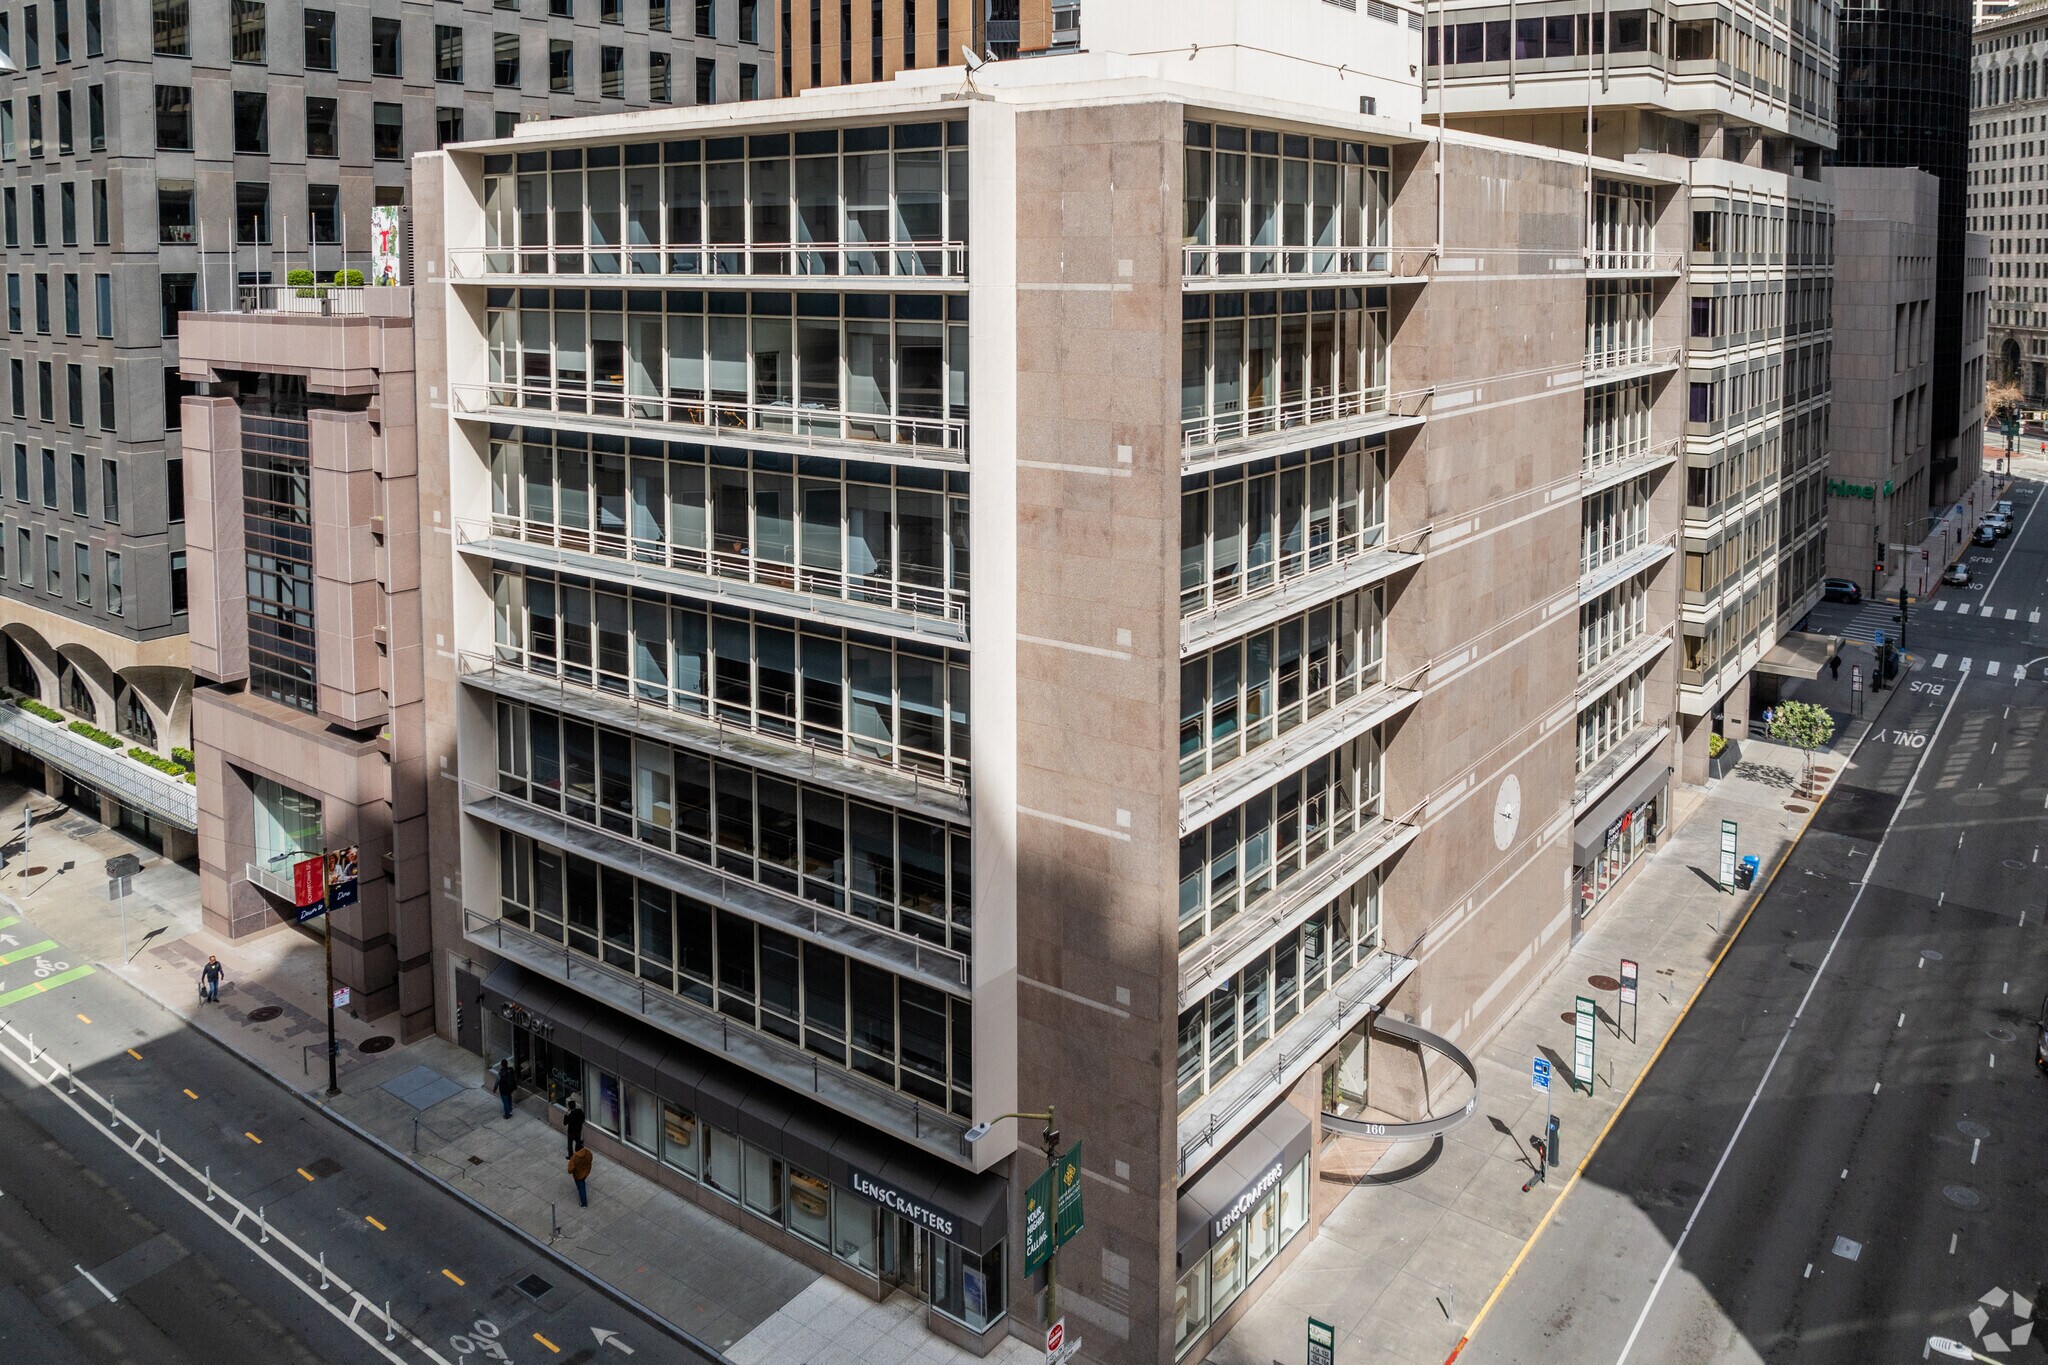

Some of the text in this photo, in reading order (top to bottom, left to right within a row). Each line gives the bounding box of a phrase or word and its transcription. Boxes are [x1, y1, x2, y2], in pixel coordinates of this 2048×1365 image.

[1827, 478, 1875, 499] hime
[1970, 556, 1993, 564] BUS
[1909, 681, 1944, 695] BUS
[1872, 728, 1926, 748] ONLY
[1365, 1124, 1386, 1135] 160
[853, 1173, 953, 1236] LENSCRAFTERS
[1215, 1163, 1283, 1238] LENSCRAFTERS
[1027, 1205, 1041, 1224] YOUR
[1027, 1211, 1045, 1236] HIGHER
[1027, 1234, 1033, 1247] IS
